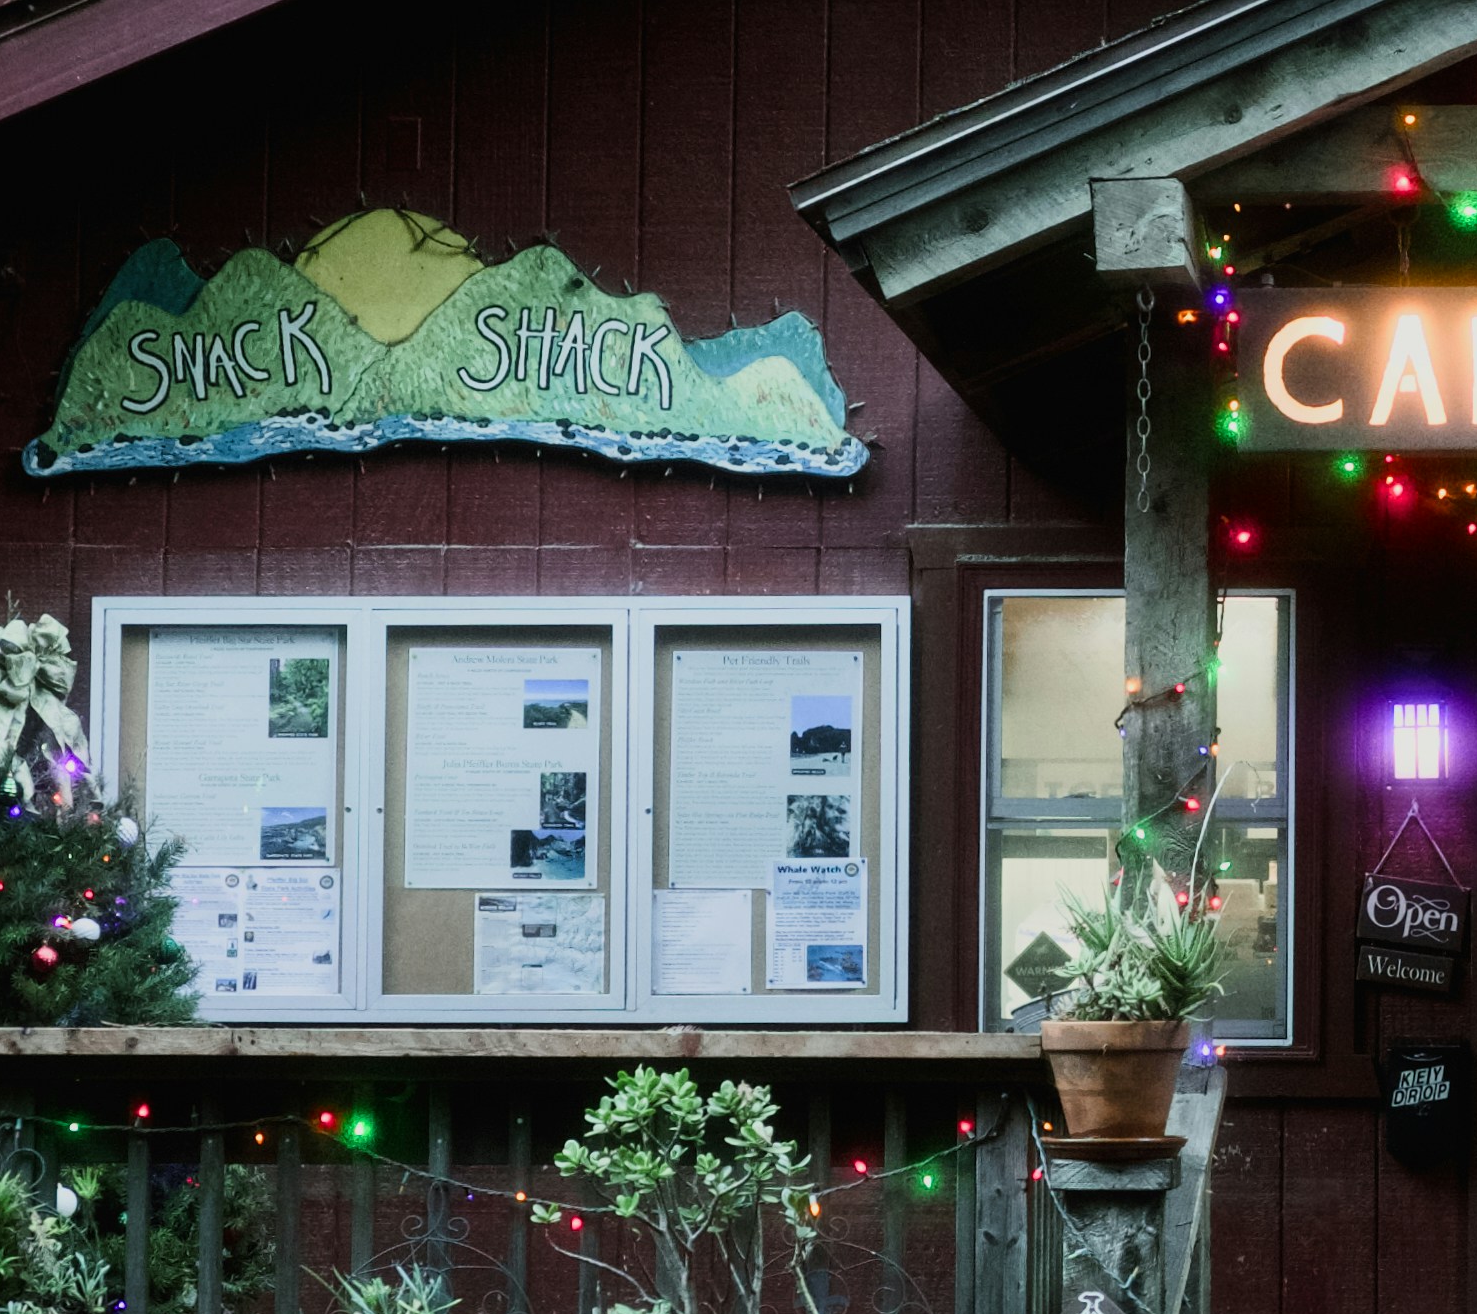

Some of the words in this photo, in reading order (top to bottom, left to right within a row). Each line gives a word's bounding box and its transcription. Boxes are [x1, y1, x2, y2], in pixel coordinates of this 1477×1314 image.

[120, 301, 333, 414] SNACK
[456, 304, 673, 411] SHACK
[451, 655, 484, 664] Andrew
[517, 655, 538, 664] State
[539, 655, 558, 664] Park
[722, 655, 739, 665] Pet
[741, 655, 780, 666] Friendly
[784, 655, 811, 665] Trails
[522, 759, 543, 768] State
[544, 759, 563, 768] Park
[261, 773, 281, 782] Park
[777, 865, 808, 874] Whale
[810, 865, 842, 874] Watch
[1366, 884, 1459, 944] Open
[1367, 954, 1446, 985] Welcome
[1400, 1066, 1443, 1088] KEY
[1393, 1083, 1448, 1106] DROP
